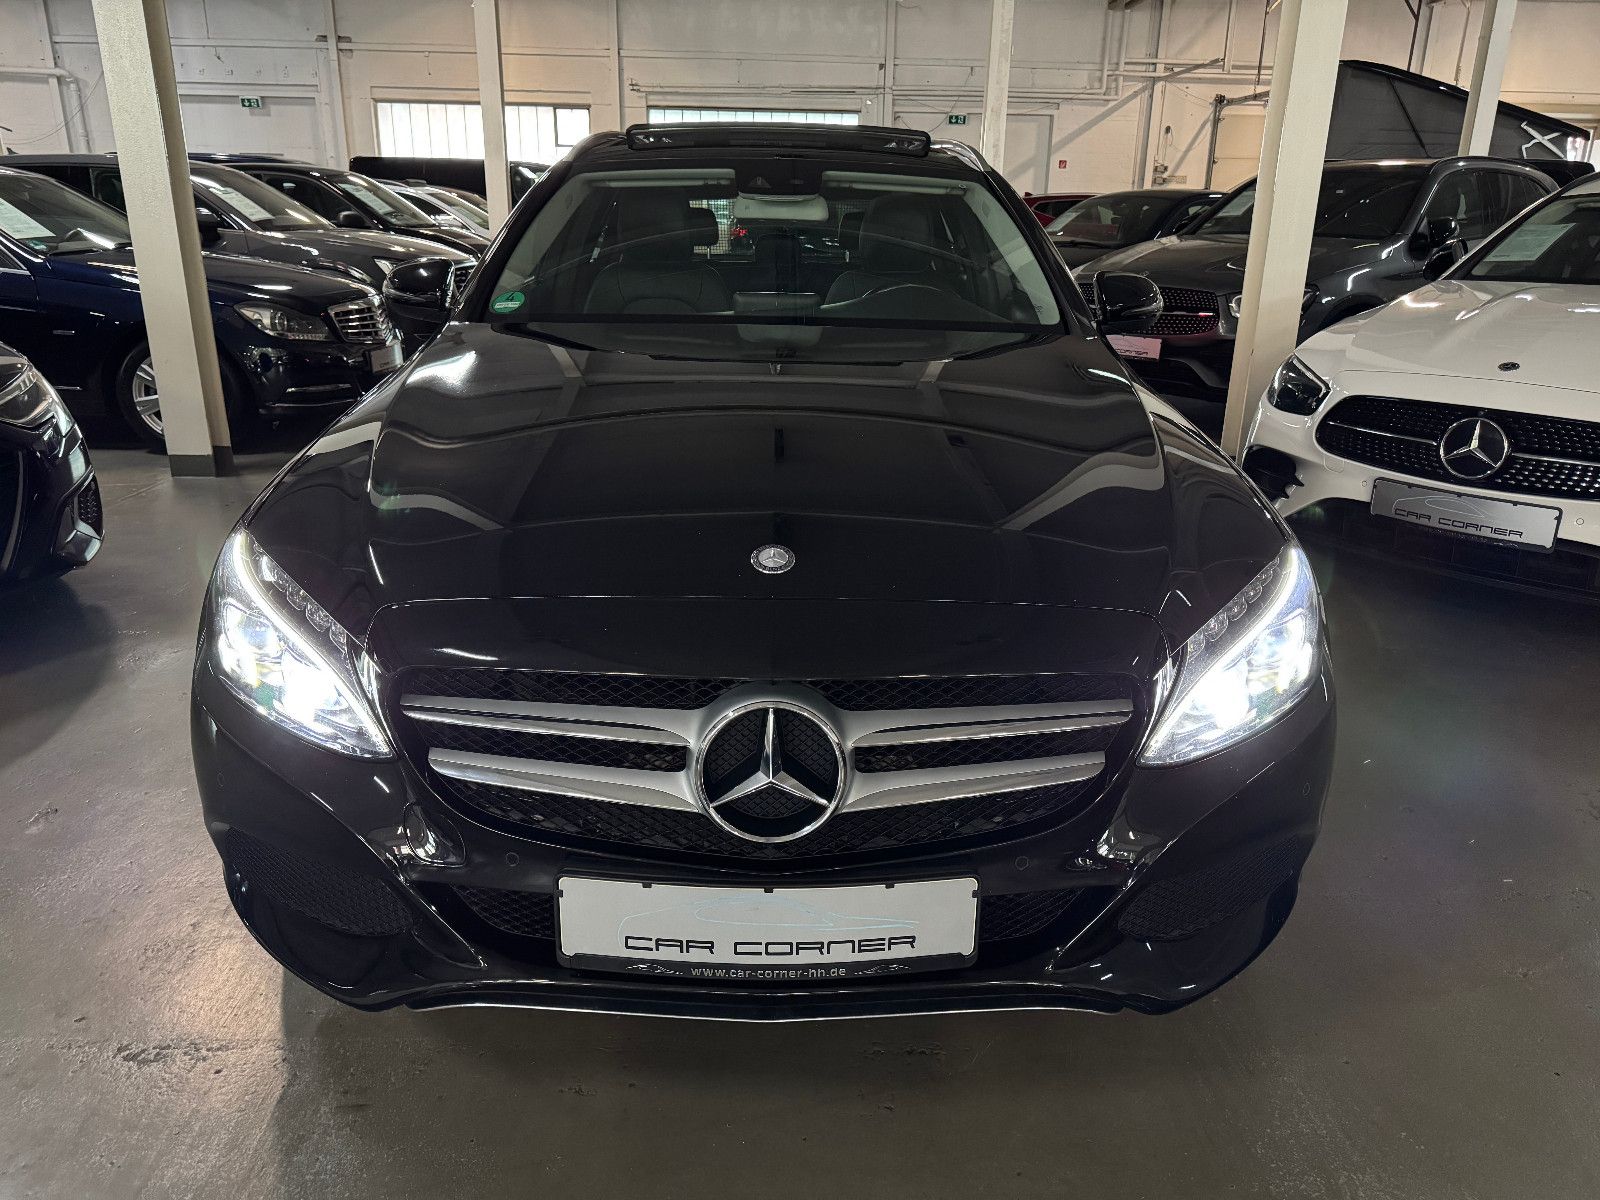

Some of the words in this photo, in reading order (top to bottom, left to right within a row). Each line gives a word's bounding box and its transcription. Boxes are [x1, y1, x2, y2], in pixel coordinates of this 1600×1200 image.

[505, 291, 516, 302] 4
[1394, 508, 1431, 523] CAR
[1438, 517, 1523, 538] CORNER
[625, 935, 714, 954] CAR
[734, 935, 917, 955] CORNER
